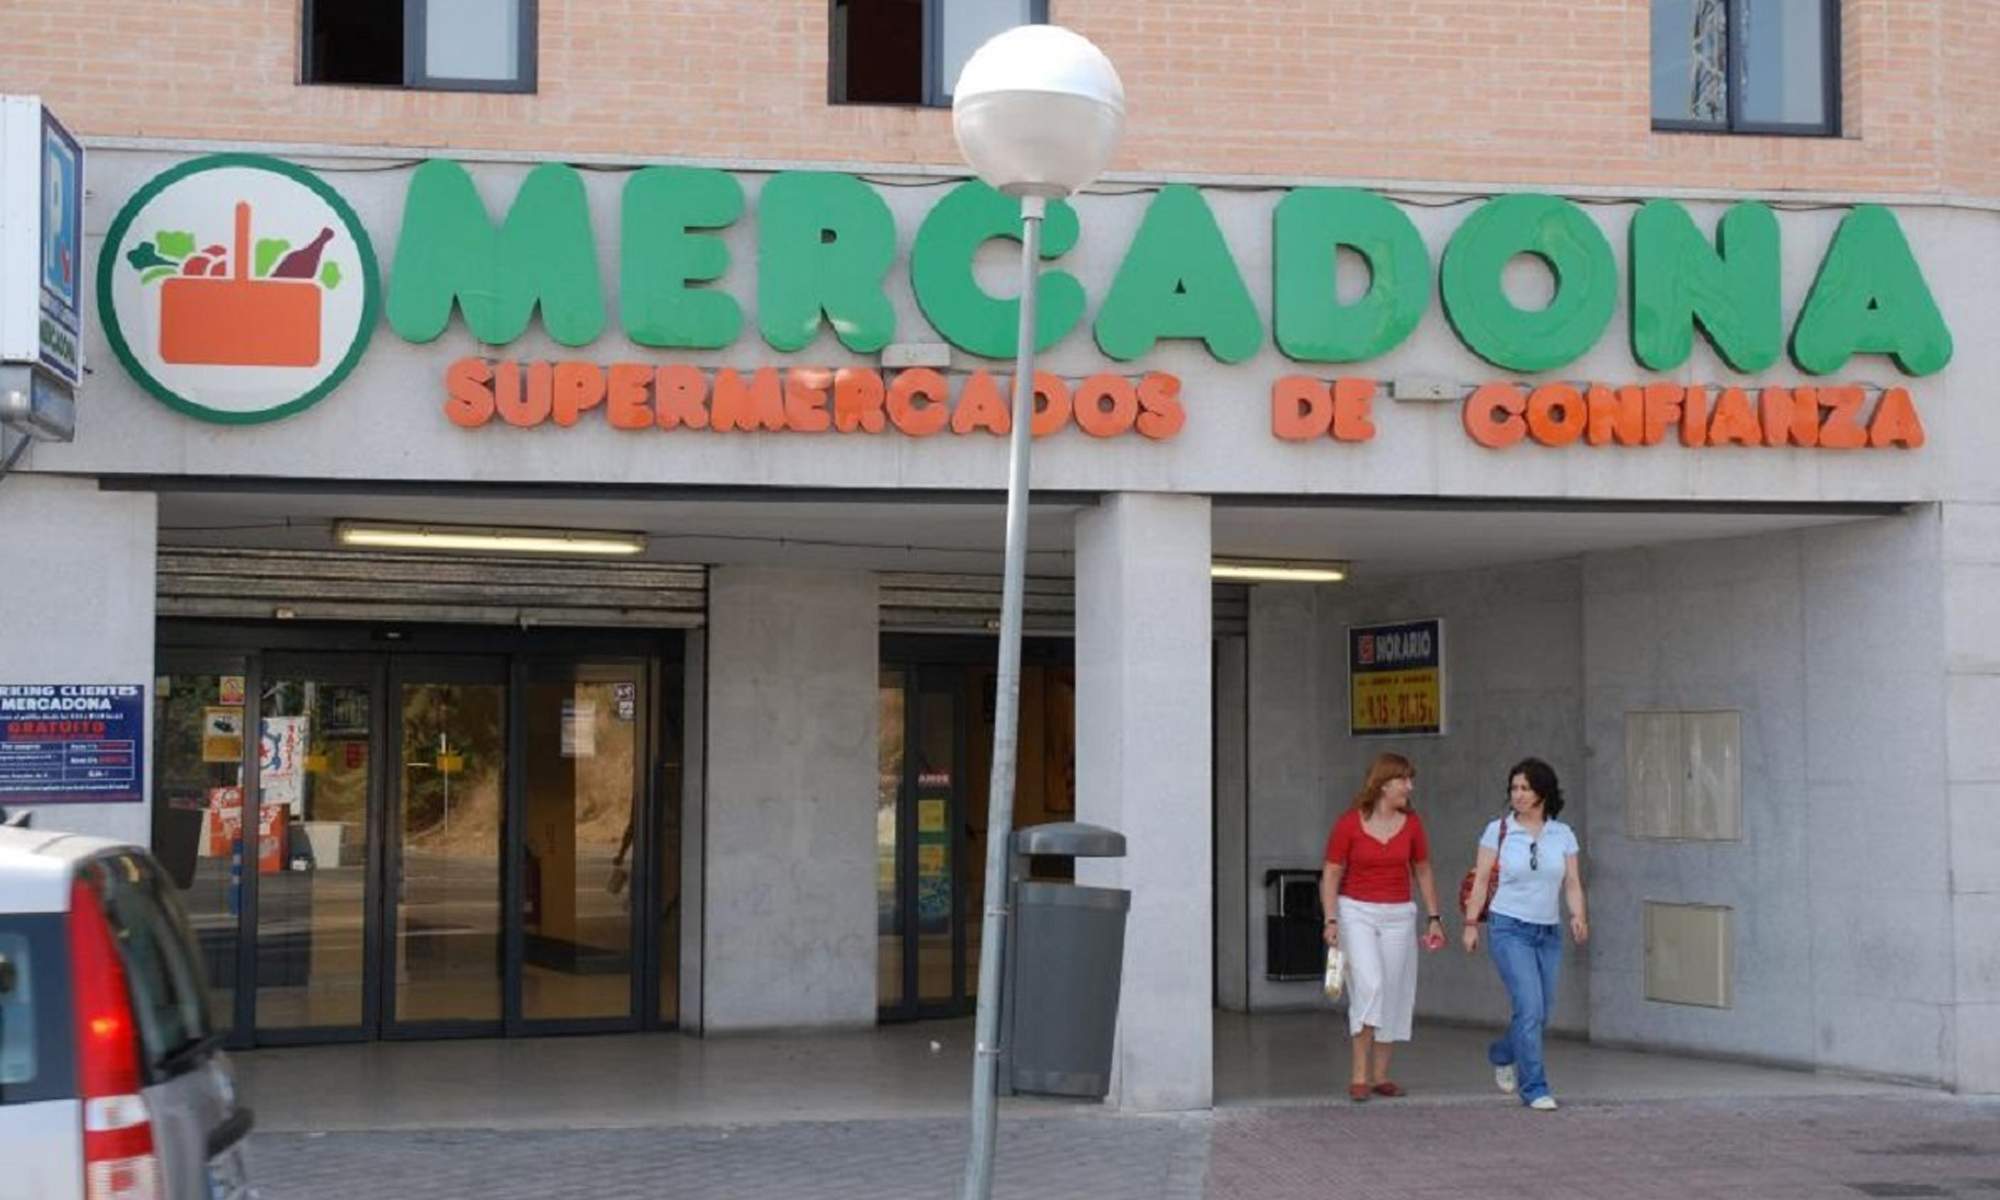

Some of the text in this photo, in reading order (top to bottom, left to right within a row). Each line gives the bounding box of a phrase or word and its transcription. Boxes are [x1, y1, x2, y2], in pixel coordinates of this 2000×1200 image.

[386, 158, 1953, 377] MERCADONA
[444, 356, 1924, 449] SUPERMERCADOS DE CONFIANZA
[1, 698, 112, 711] MERCADONA
[60, 686, 138, 696] CLIENTES
